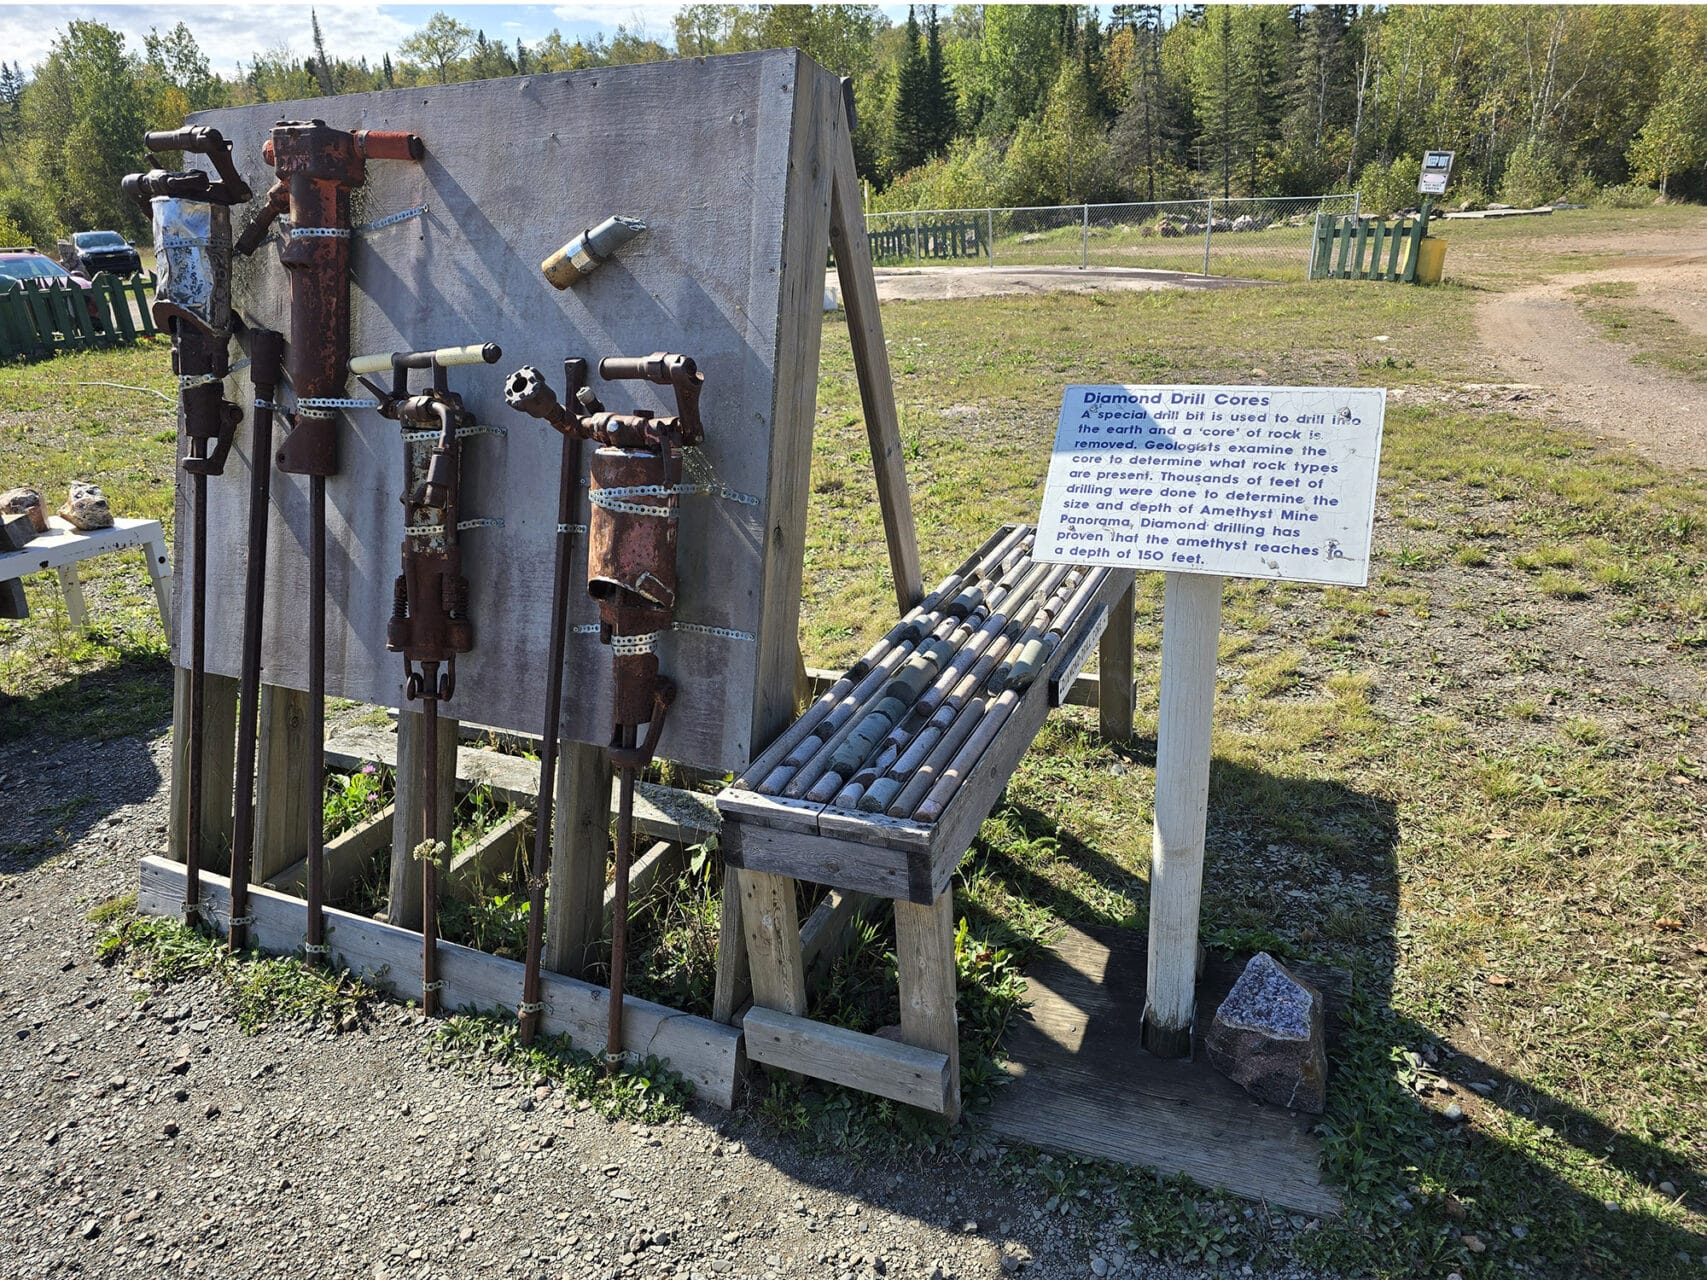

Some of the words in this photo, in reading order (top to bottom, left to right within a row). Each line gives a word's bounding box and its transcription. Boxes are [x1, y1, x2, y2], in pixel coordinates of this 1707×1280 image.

[1084, 392, 1163, 406] Diamond
[1170, 392, 1206, 405] Drill
[1214, 393, 1270, 407] Cores
[1081, 410, 1092, 419] A
[1098, 410, 1147, 421] special
[1153, 410, 1180, 420] drill
[1185, 411, 1206, 421] bit
[1211, 411, 1223, 421] is
[1230, 412, 1267, 423] used
[1274, 413, 1289, 424] to
[1296, 414, 1325, 425] drill
[1332, 414, 1361, 425] ino
[1078, 424, 1100, 434] the
[1106, 425, 1143, 434] earth
[1148, 426, 1177, 435] and
[1182, 428, 1192, 436] a
[1246, 428, 1262, 438] of
[1268, 429, 1302, 440] rock
[1074, 440, 1137, 451] removed.
[1144, 440, 1221, 454] Geologists
[1228, 444, 1294, 455] examine
[1302, 446, 1327, 457] the
[1072, 456, 1102, 464] core
[1109, 455, 1123, 465] to
[1129, 455, 1202, 467] determine
[1209, 458, 1246, 469] what
[1252, 460, 1287, 471] rock
[1294, 461, 1338, 474] types
[1069, 470, 1091, 478] are
[1096, 470, 1153, 481] present.
[1161, 471, 1239, 485] Thousands
[1246, 475, 1263, 486] of
[1270, 476, 1301, 488] feet
[1308, 478, 1324, 489] of
[1066, 484, 1113, 497] drilling
[1119, 488, 1153, 496] were
[1160, 487, 1197, 498] done
[1204, 489, 1219, 499] to
[1225, 490, 1306, 504] determine
[1313, 495, 1339, 506] the
[1063, 499, 1090, 509] size
[1096, 501, 1124, 511] and
[1130, 501, 1172, 514] depth
[1178, 504, 1194, 514] of
[1200, 505, 1273, 520] Amethyst
[1280, 509, 1319, 522] Mine
[1140, 518, 1207, 531] Diamond
[1213, 522, 1265, 538] drilling
[1272, 525, 1300, 538] has
[1056, 529, 1103, 542] proven
[1146, 534, 1170, 545] the
[1176, 538, 1248, 552] amethyst
[1254, 543, 1319, 556] reaches
[1054, 547, 1064, 555] a
[1069, 546, 1110, 559] depth
[1116, 548, 1132, 559] of
[1138, 550, 1164, 561] 150
[1171, 552, 1205, 567] feet.
